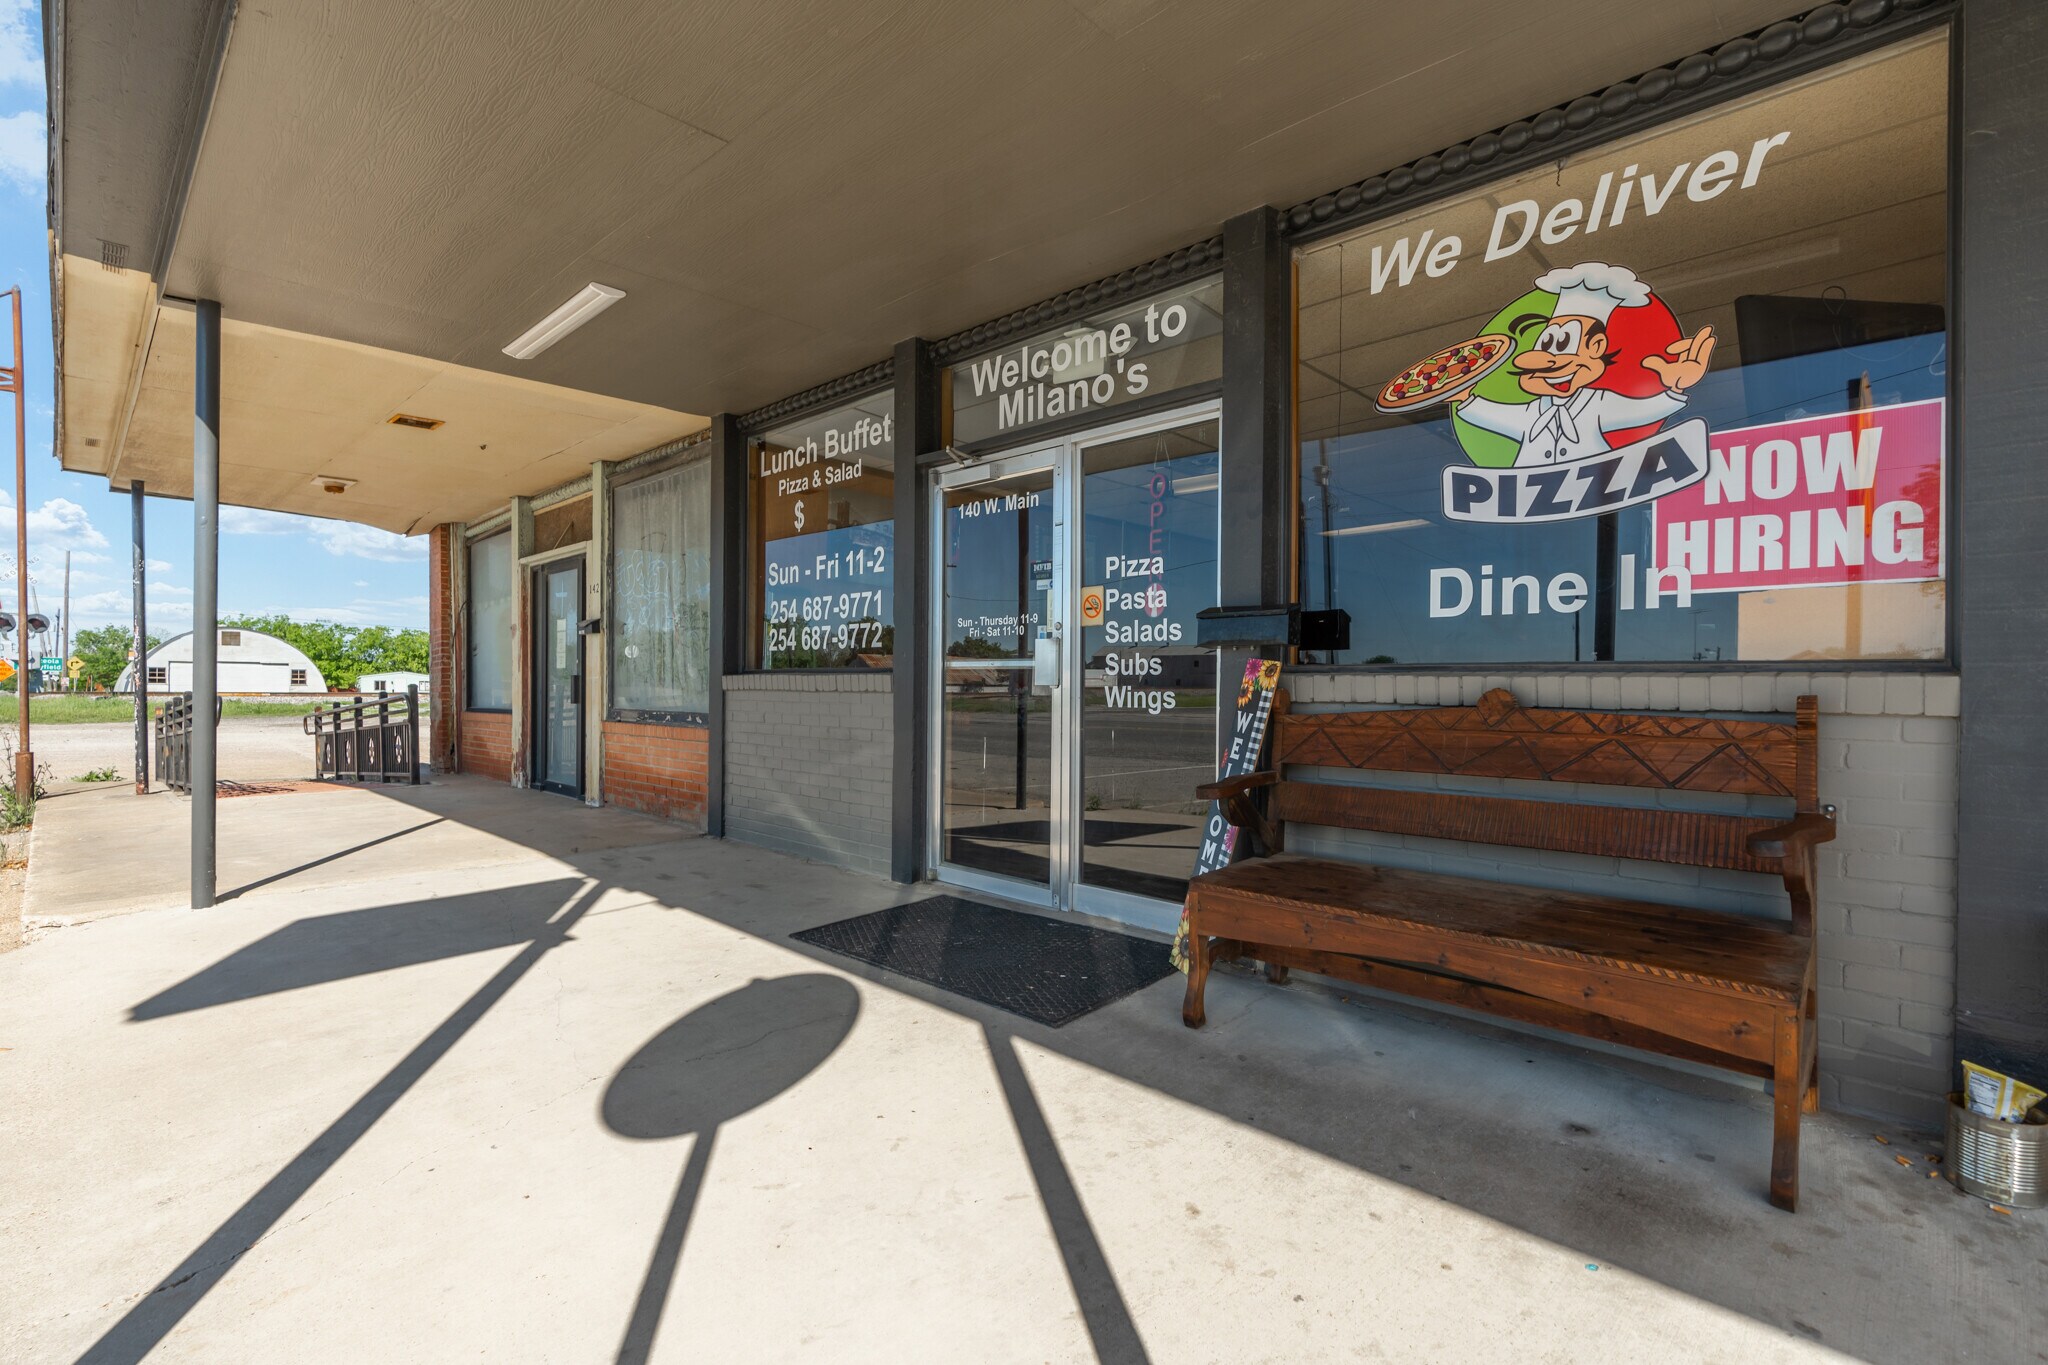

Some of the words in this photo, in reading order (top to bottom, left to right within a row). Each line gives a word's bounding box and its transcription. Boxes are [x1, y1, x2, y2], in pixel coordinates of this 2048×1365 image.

[1369, 229, 1462, 295] We
[1482, 130, 1791, 263] Deliver
[971, 322, 1131, 397] Welcome
[1145, 303, 1187, 344] to
[999, 358, 1149, 430] Milano's
[760, 436, 818, 478] Lunch
[825, 412, 892, 459] Buffet
[778, 478, 809, 497] Pizza
[812, 469, 821, 488] &
[825, 458, 862, 485] Salad
[1451, 437, 1699, 517] PIZZA
[1704, 426, 1883, 506] NOW
[794, 499, 805, 532] $
[958, 500, 981, 519] 140
[984, 497, 1000, 515] W.
[1005, 491, 1039, 512] Main
[1667, 500, 1925, 576] HIRING
[768, 562, 799, 586] Sun
[816, 553, 839, 580] Fri
[845, 546, 885, 577] 11-2
[1105, 555, 1164, 579] Pizza
[1105, 588, 1168, 612] Pasta
[1429, 564, 1588, 618] Dine
[1620, 553, 1692, 611] In
[770, 598, 798, 624] 254
[802, 589, 883, 622] 687-9771
[957, 617, 973, 628] Sun
[980, 614, 1018, 627] Thursday
[1020, 613, 1039, 624] 11-9
[769, 627, 797, 652] 254
[801, 621, 883, 651] 687-9772
[969, 628, 980, 638] Fri
[986, 626, 1001, 637] Sat
[1002, 625, 1025, 636] 11-10
[1105, 617, 1182, 644] Salads
[1105, 652, 1163, 676] Subs
[1104, 685, 1176, 715] Wings
